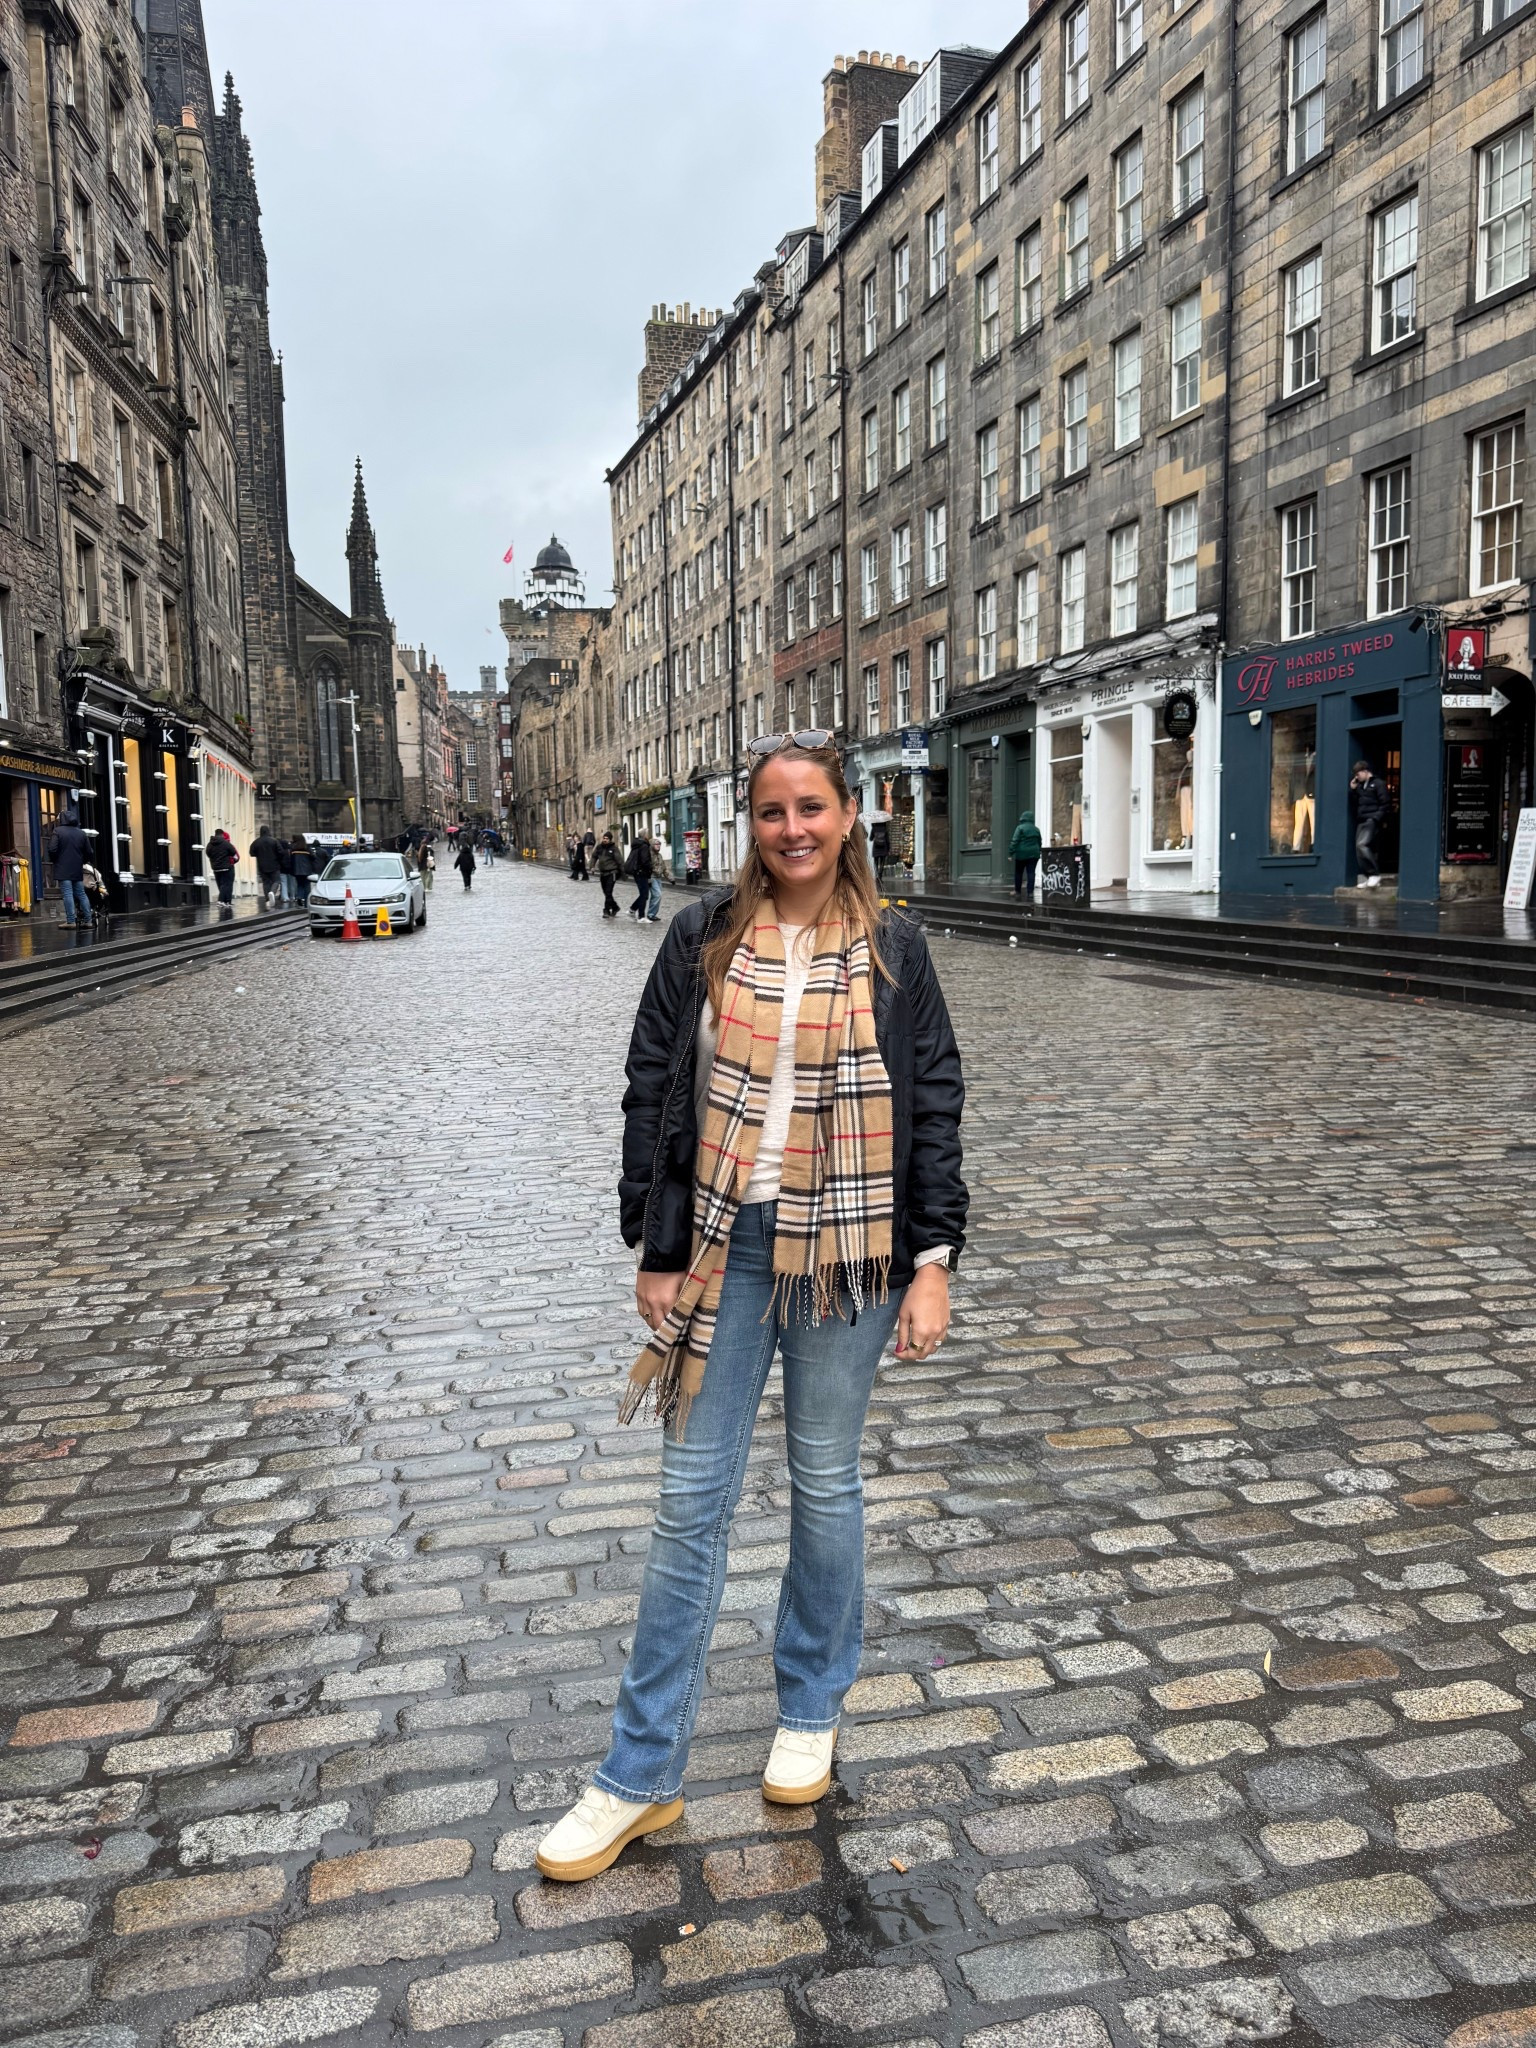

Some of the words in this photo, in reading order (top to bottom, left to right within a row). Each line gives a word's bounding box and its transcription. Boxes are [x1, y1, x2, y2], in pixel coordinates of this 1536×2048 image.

[1286, 647, 1336, 671] HARRIS
[1342, 634, 1393, 657] TWEED
[1287, 662, 1355, 689] HEBRIDES
[1464, 673, 1482, 681] JUDGE
[1091, 680, 1134, 702] PRINGLE
[1443, 697, 1471, 706] CAFE
[162, 729, 175, 743] K
[1, 755, 35, 772] CASHMERE
[35, 763, 41, 774] &
[41, 764, 77, 780] LAMBSWOOL
[262, 784, 271, 796] K
